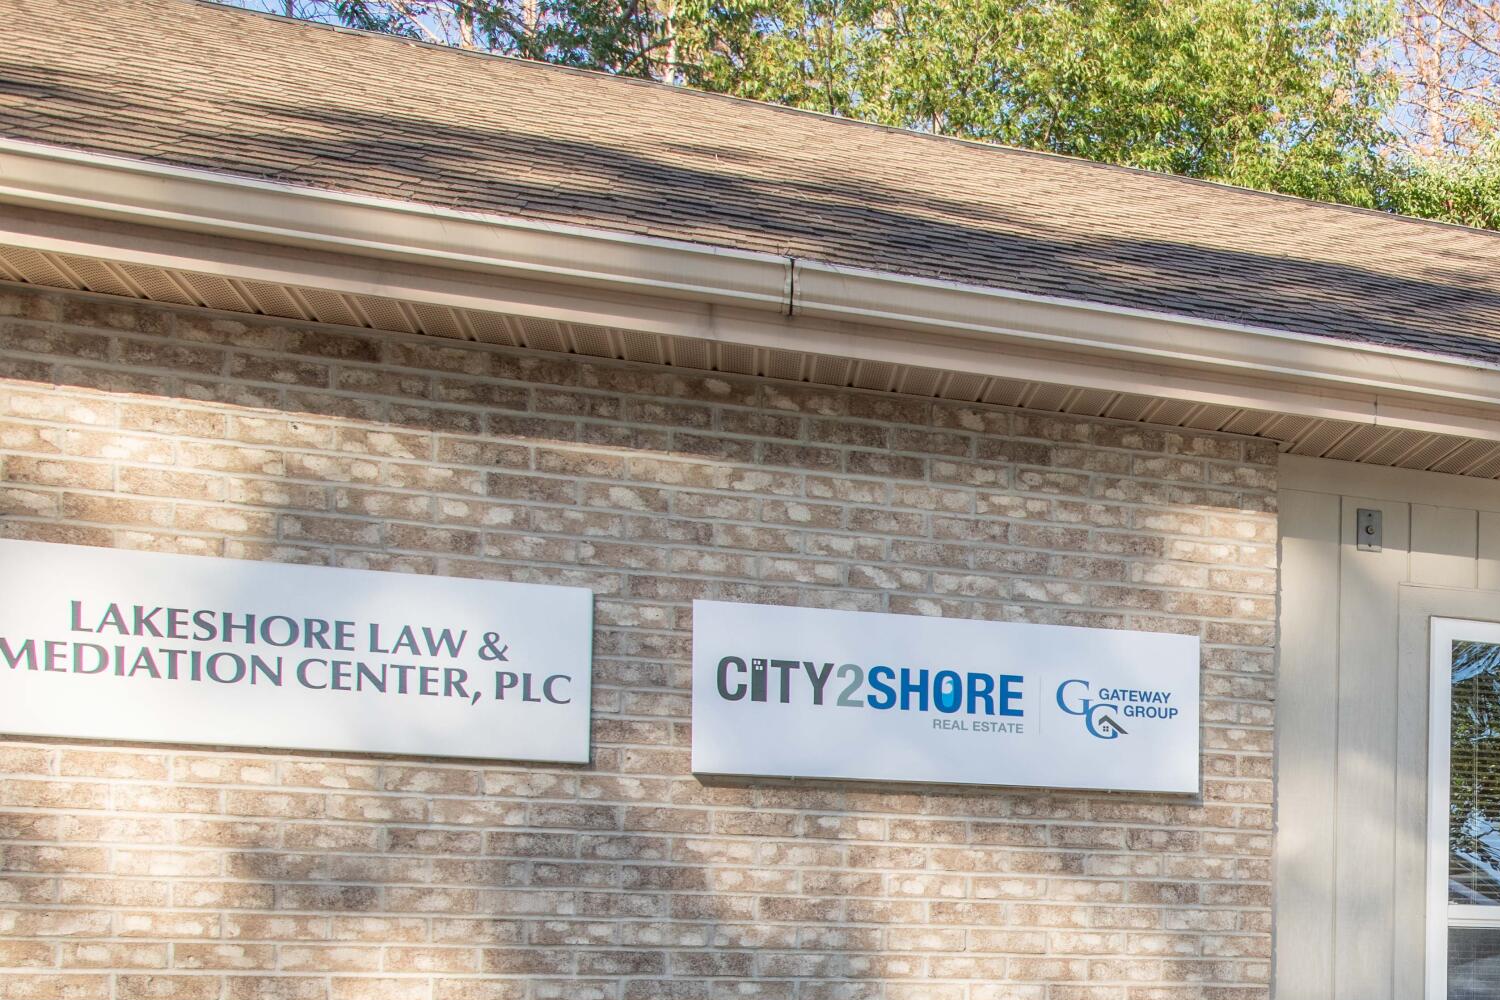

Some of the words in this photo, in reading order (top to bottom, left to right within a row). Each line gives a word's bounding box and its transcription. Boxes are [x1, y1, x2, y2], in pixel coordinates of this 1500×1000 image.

[70, 599, 355, 652] LAKESHORE
[368, 623, 467, 661] LAW
[478, 632, 509, 662] &
[0, 637, 283, 687] MEDIATION
[296, 657, 482, 706] CENTER,
[496, 672, 572, 705] PLC
[716, 655, 1025, 717] CITY2SHORE
[1098, 687, 1172, 705] GATEWAY
[1123, 705, 1179, 721] GROUP
[932, 718, 969, 732] REAL
[972, 720, 1025, 734] ESTATE
